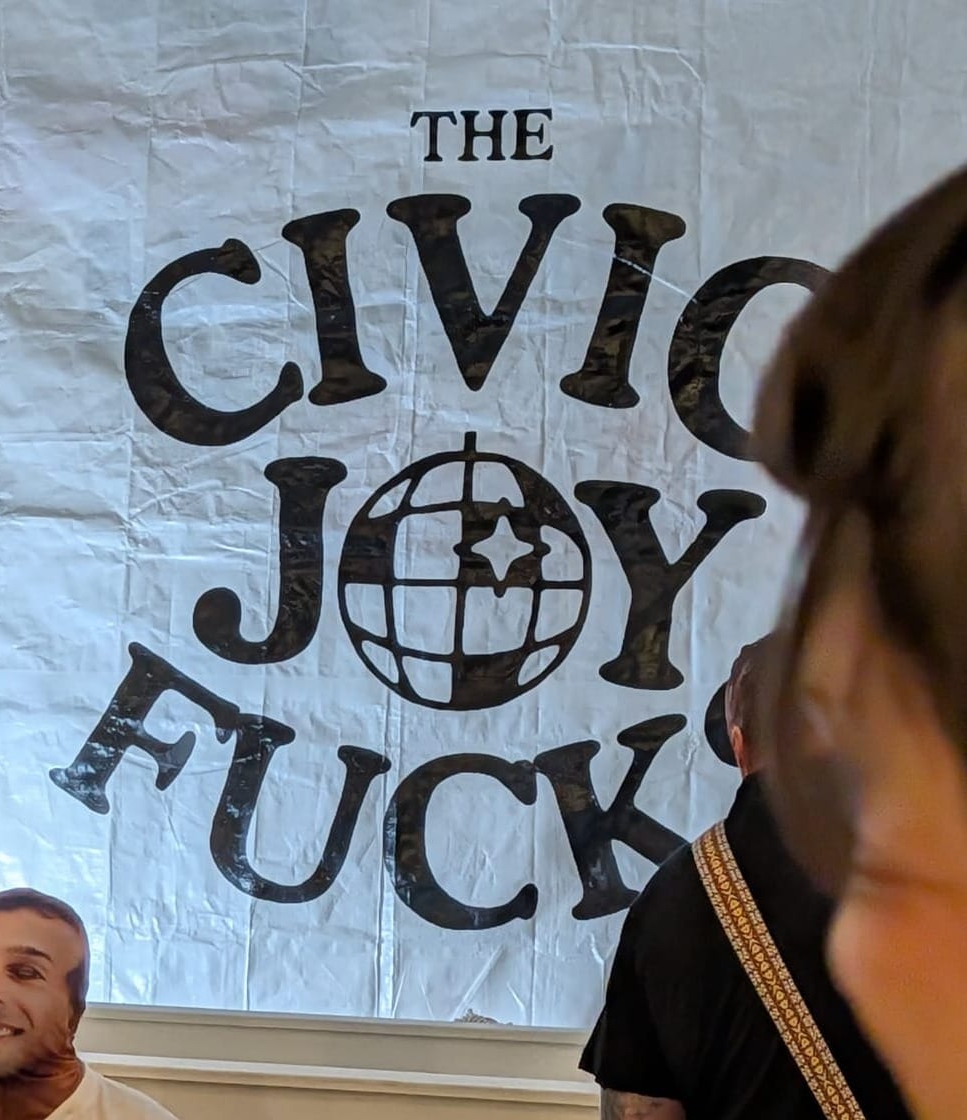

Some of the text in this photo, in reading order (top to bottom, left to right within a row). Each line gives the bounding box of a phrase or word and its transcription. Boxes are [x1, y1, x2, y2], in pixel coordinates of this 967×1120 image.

[411, 108, 554, 162] THE
[124, 193, 836, 461] CIVIC
[192, 431, 767, 711] JOY
